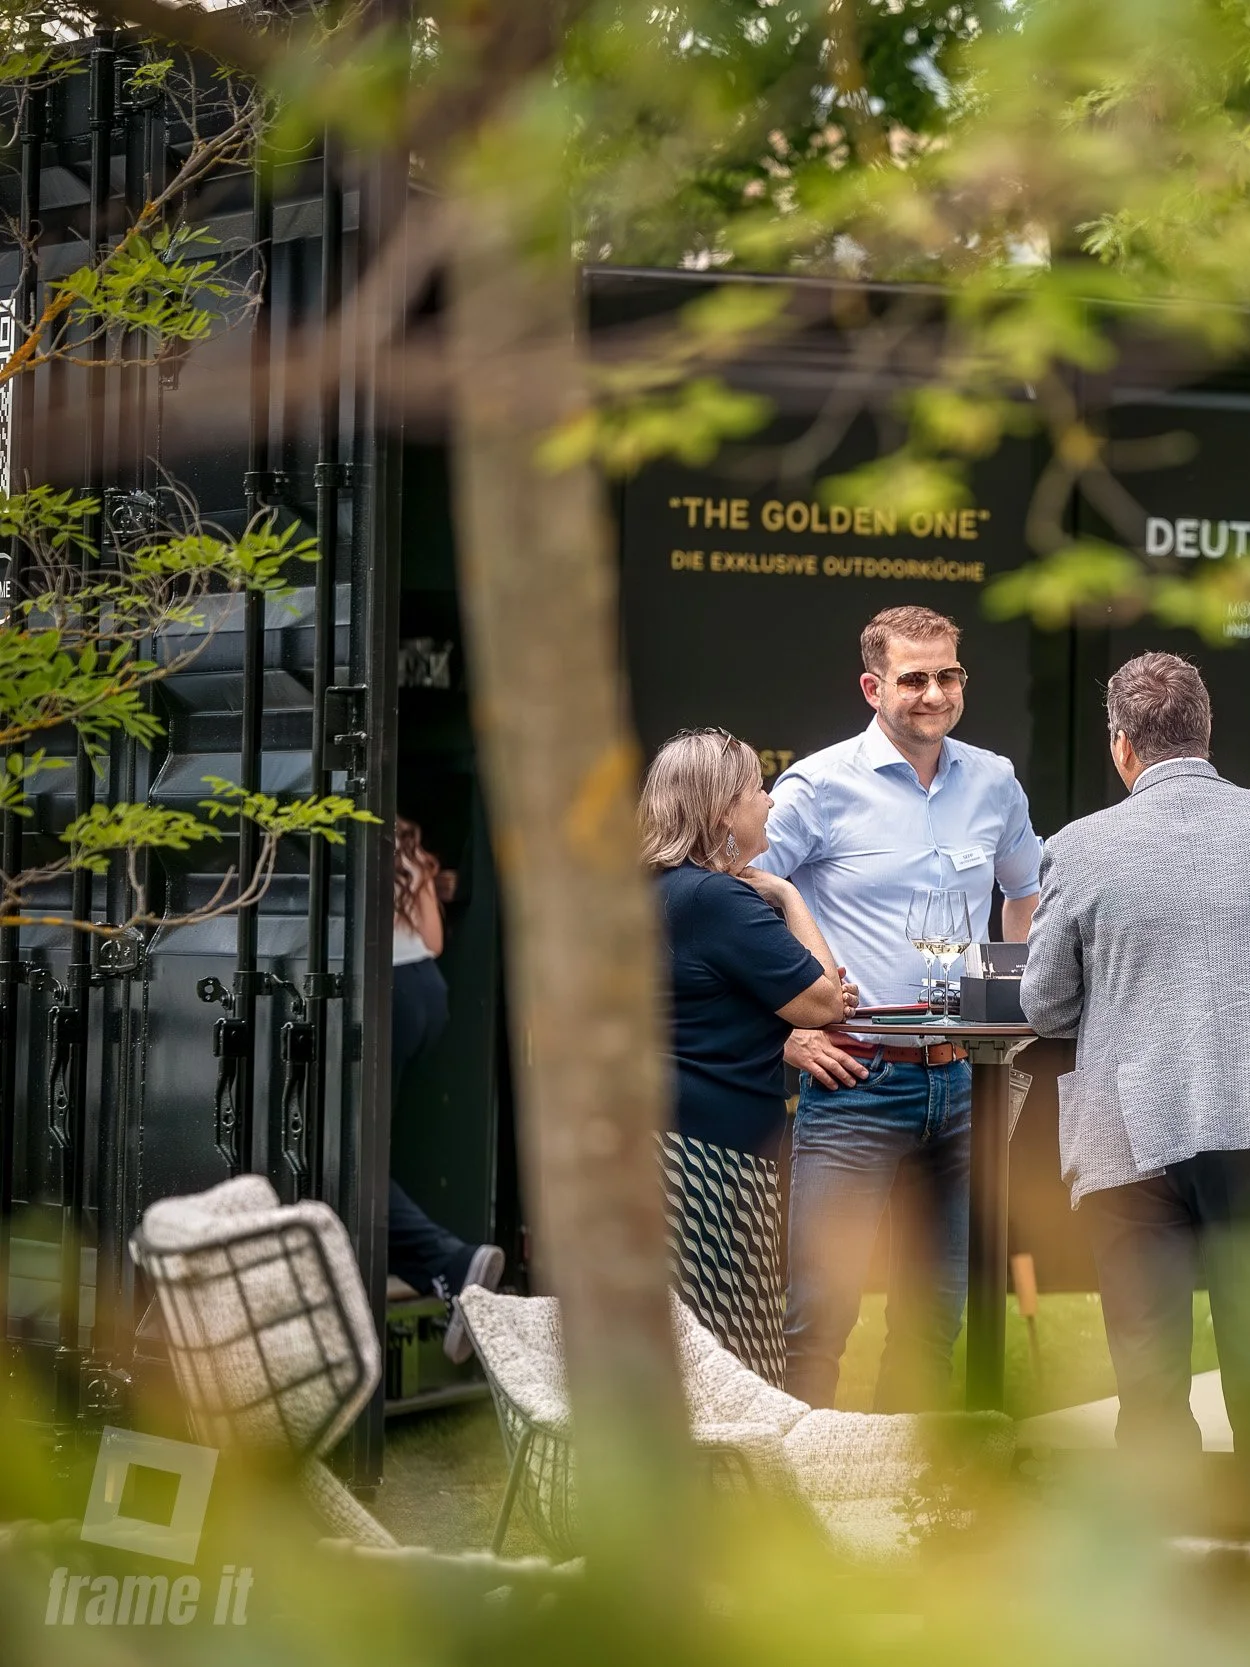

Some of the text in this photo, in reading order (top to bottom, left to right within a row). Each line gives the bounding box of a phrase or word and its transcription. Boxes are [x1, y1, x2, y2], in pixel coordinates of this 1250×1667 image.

[761, 501, 896, 537] GOLDEN
[671, 549, 985, 583] DIE EXKLUSIVE OUTDOORKÜCHE
